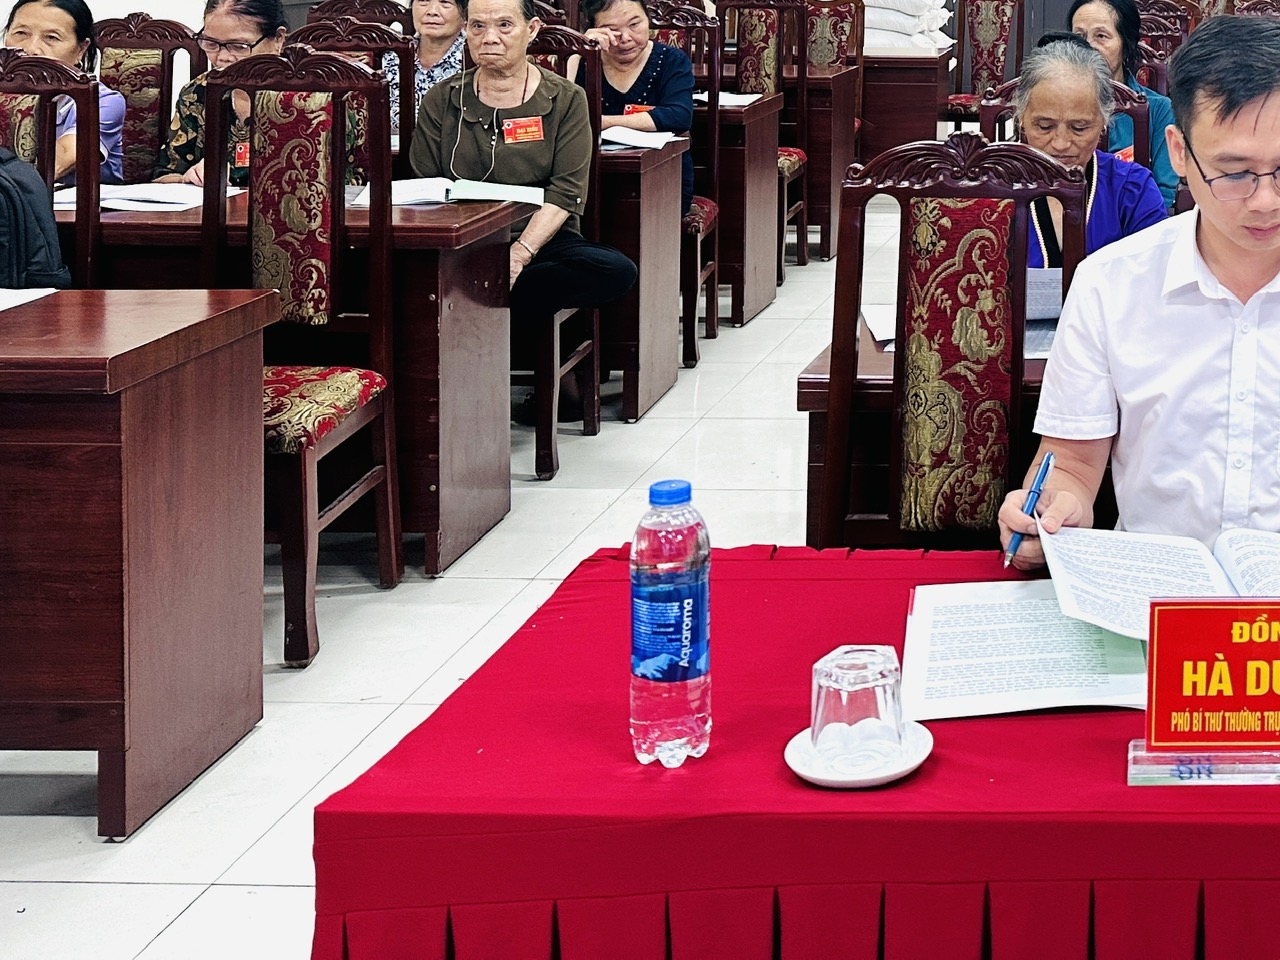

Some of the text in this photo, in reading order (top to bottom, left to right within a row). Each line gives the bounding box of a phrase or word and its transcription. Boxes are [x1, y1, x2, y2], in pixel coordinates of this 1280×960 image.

[679, 598, 693, 667] Aquaroma
[1182, 652, 1234, 697] HÀ
[1171, 707, 1191, 732] PHÓ
[1192, 707, 1203, 732] BÍ
[1204, 709, 1224, 732] THƯ
[1224, 706, 1262, 732] THƯỜNG
